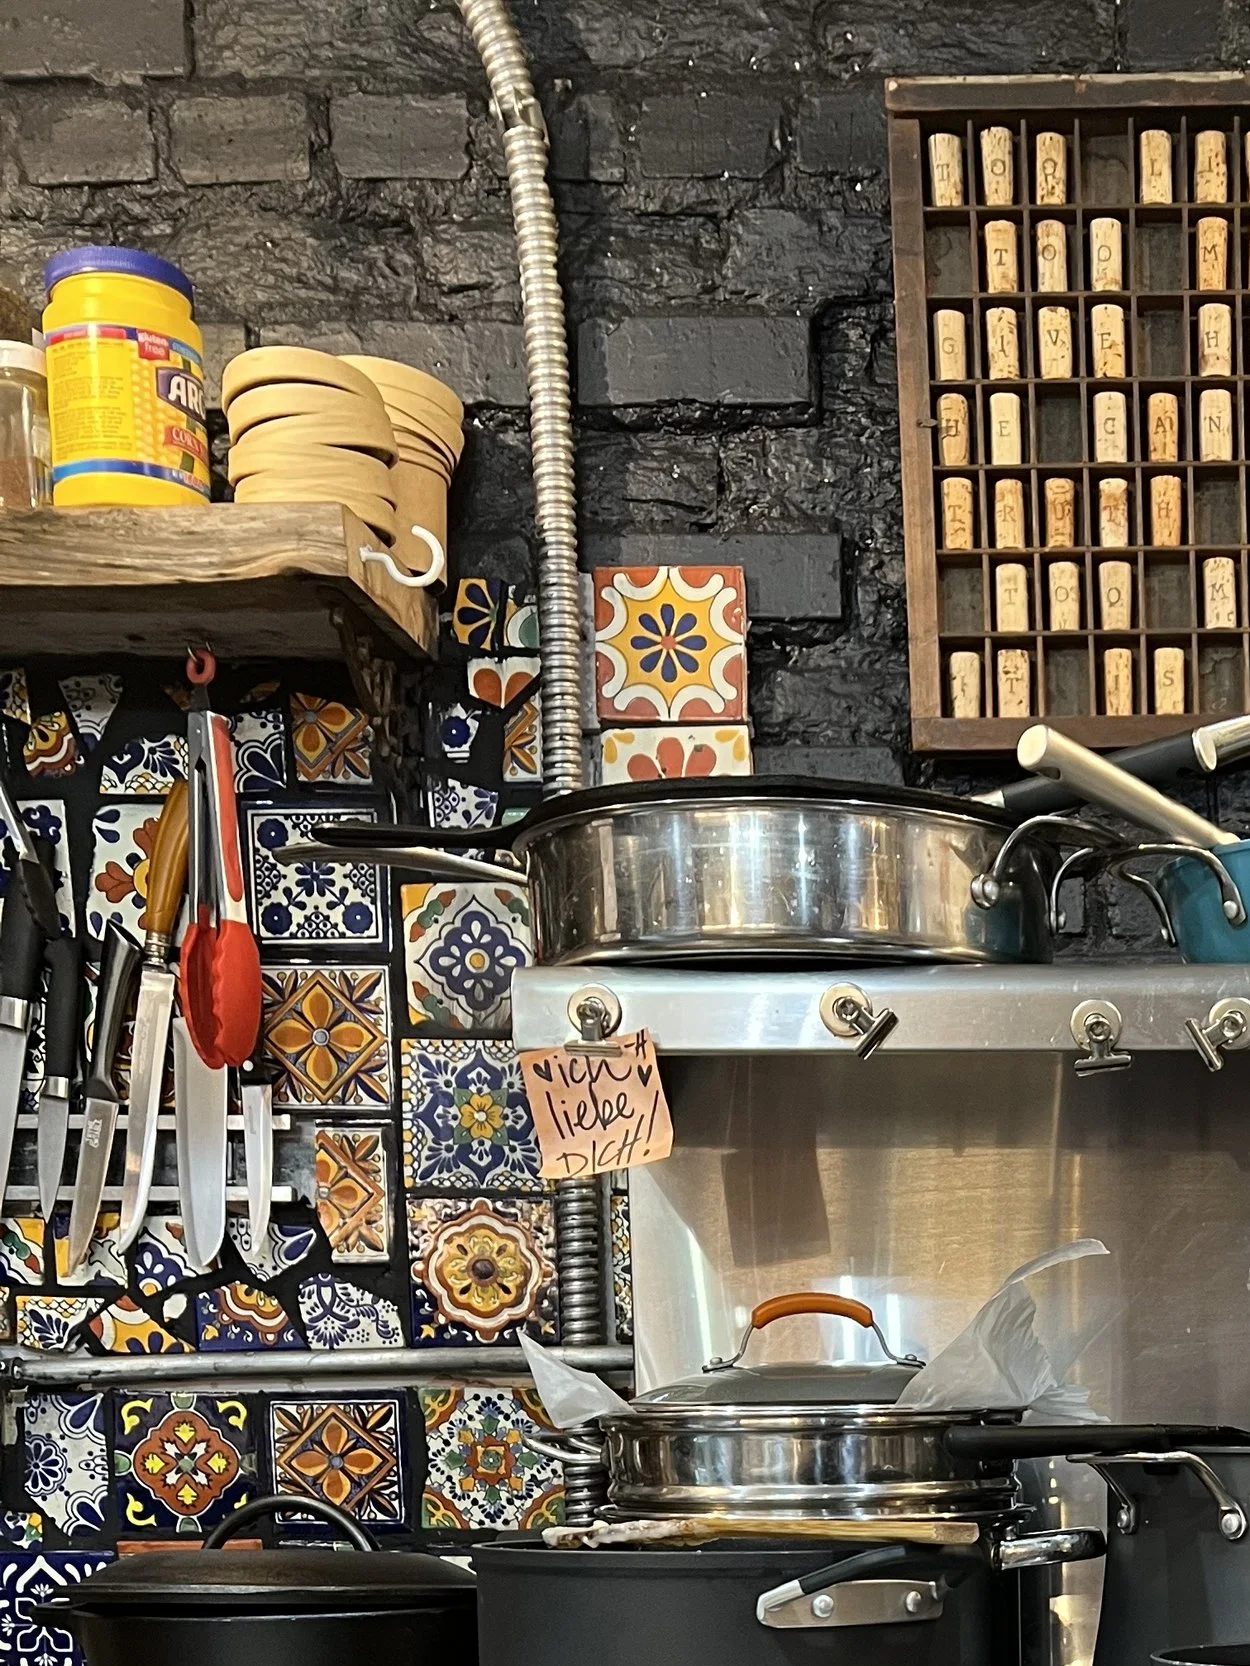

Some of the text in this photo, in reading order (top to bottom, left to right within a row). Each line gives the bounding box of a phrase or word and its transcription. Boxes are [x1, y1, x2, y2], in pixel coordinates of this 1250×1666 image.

[936, 156, 1058, 183] TOO
[993, 244, 1112, 266] TOO
[942, 329, 1114, 354] GIVE
[944, 417, 1011, 437] HE
[949, 498, 1171, 523] TRUTH
[1005, 584, 1121, 607] TOO
[1114, 670, 1175, 690] IS
[553, 1055, 632, 1088] ich
[546, 1090, 635, 1140] liebe
[556, 1090, 659, 1176] DICH!
